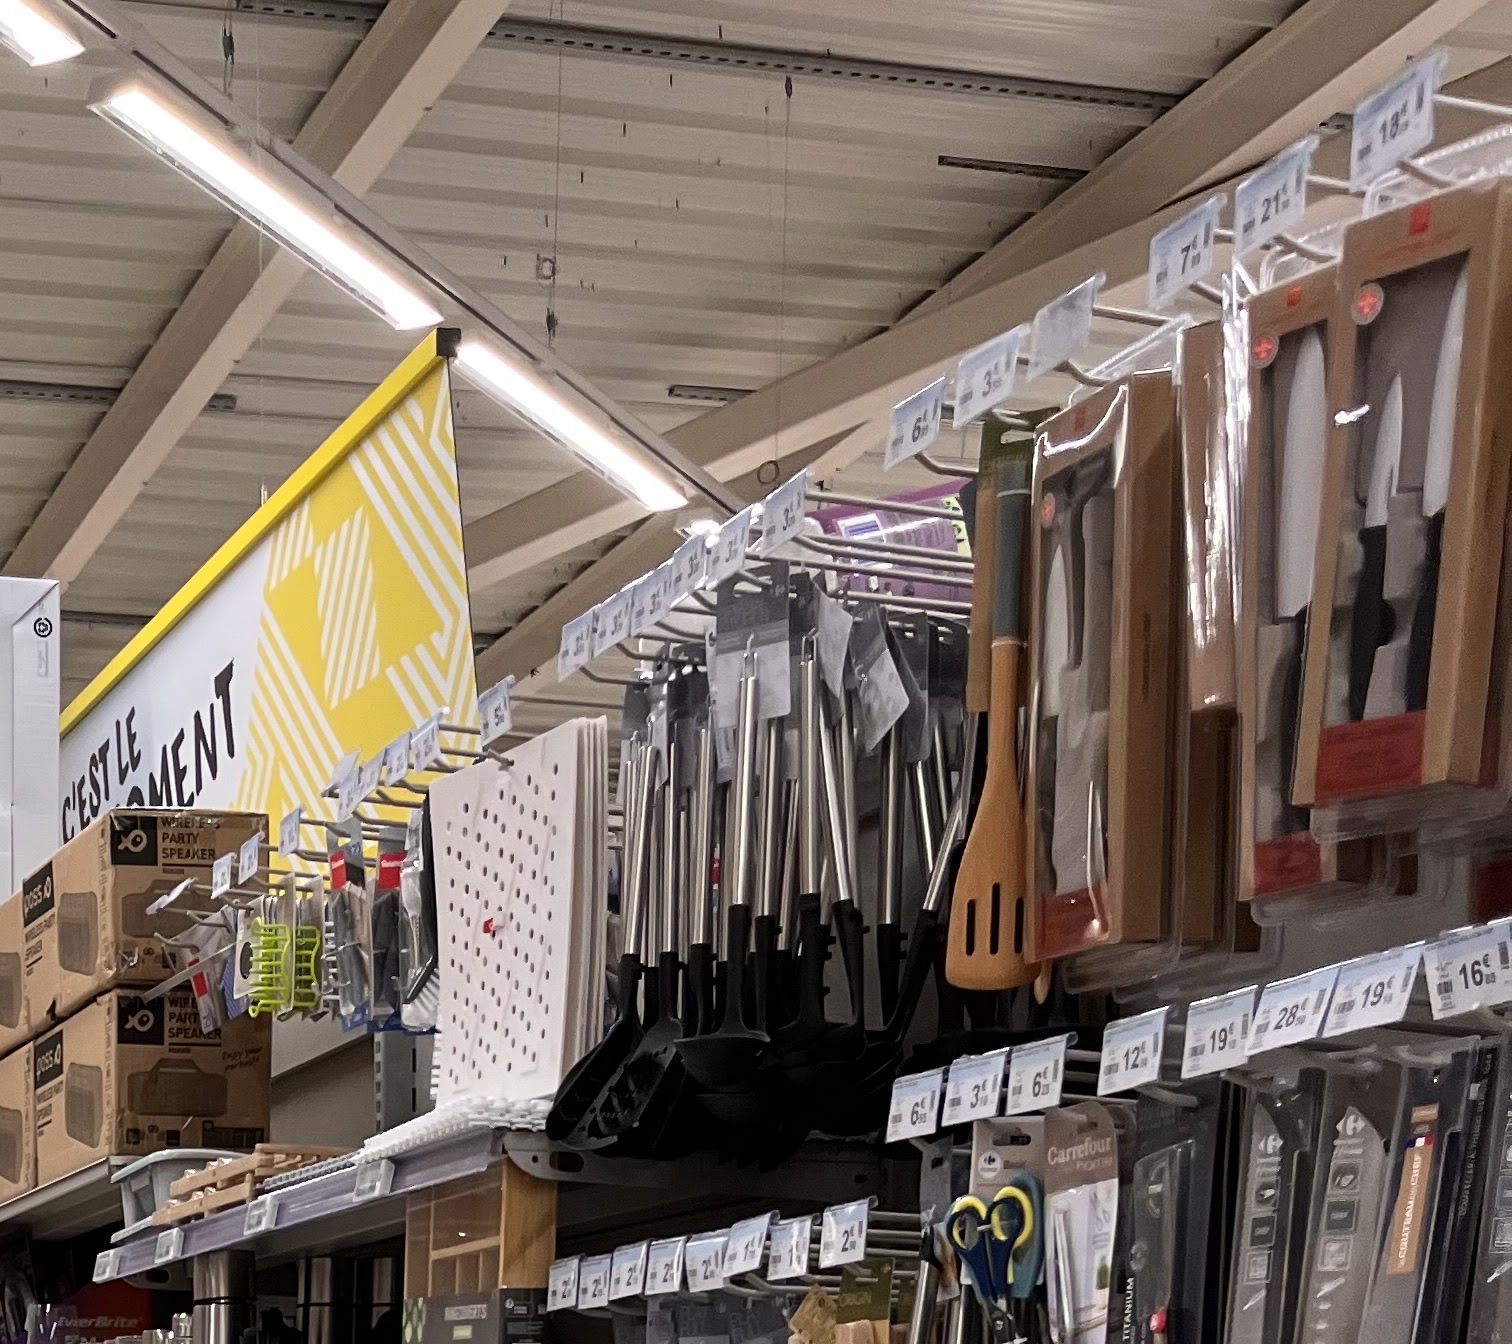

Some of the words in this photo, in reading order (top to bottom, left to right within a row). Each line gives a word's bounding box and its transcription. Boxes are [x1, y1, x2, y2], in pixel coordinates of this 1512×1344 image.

[115, 657, 235, 807] MENT
[62, 737, 110, 846] C'EST
[115, 706, 142, 786] LE
[161, 832, 200, 845] PARTY
[161, 848, 217, 860] SPEAKER
[168, 1013, 200, 1025] PART
[168, 1028, 222, 1040] SPEAKER
[1047, 1136, 1111, 1166] Carrefour
[1122, 1276, 1136, 1344] TITANIUM
